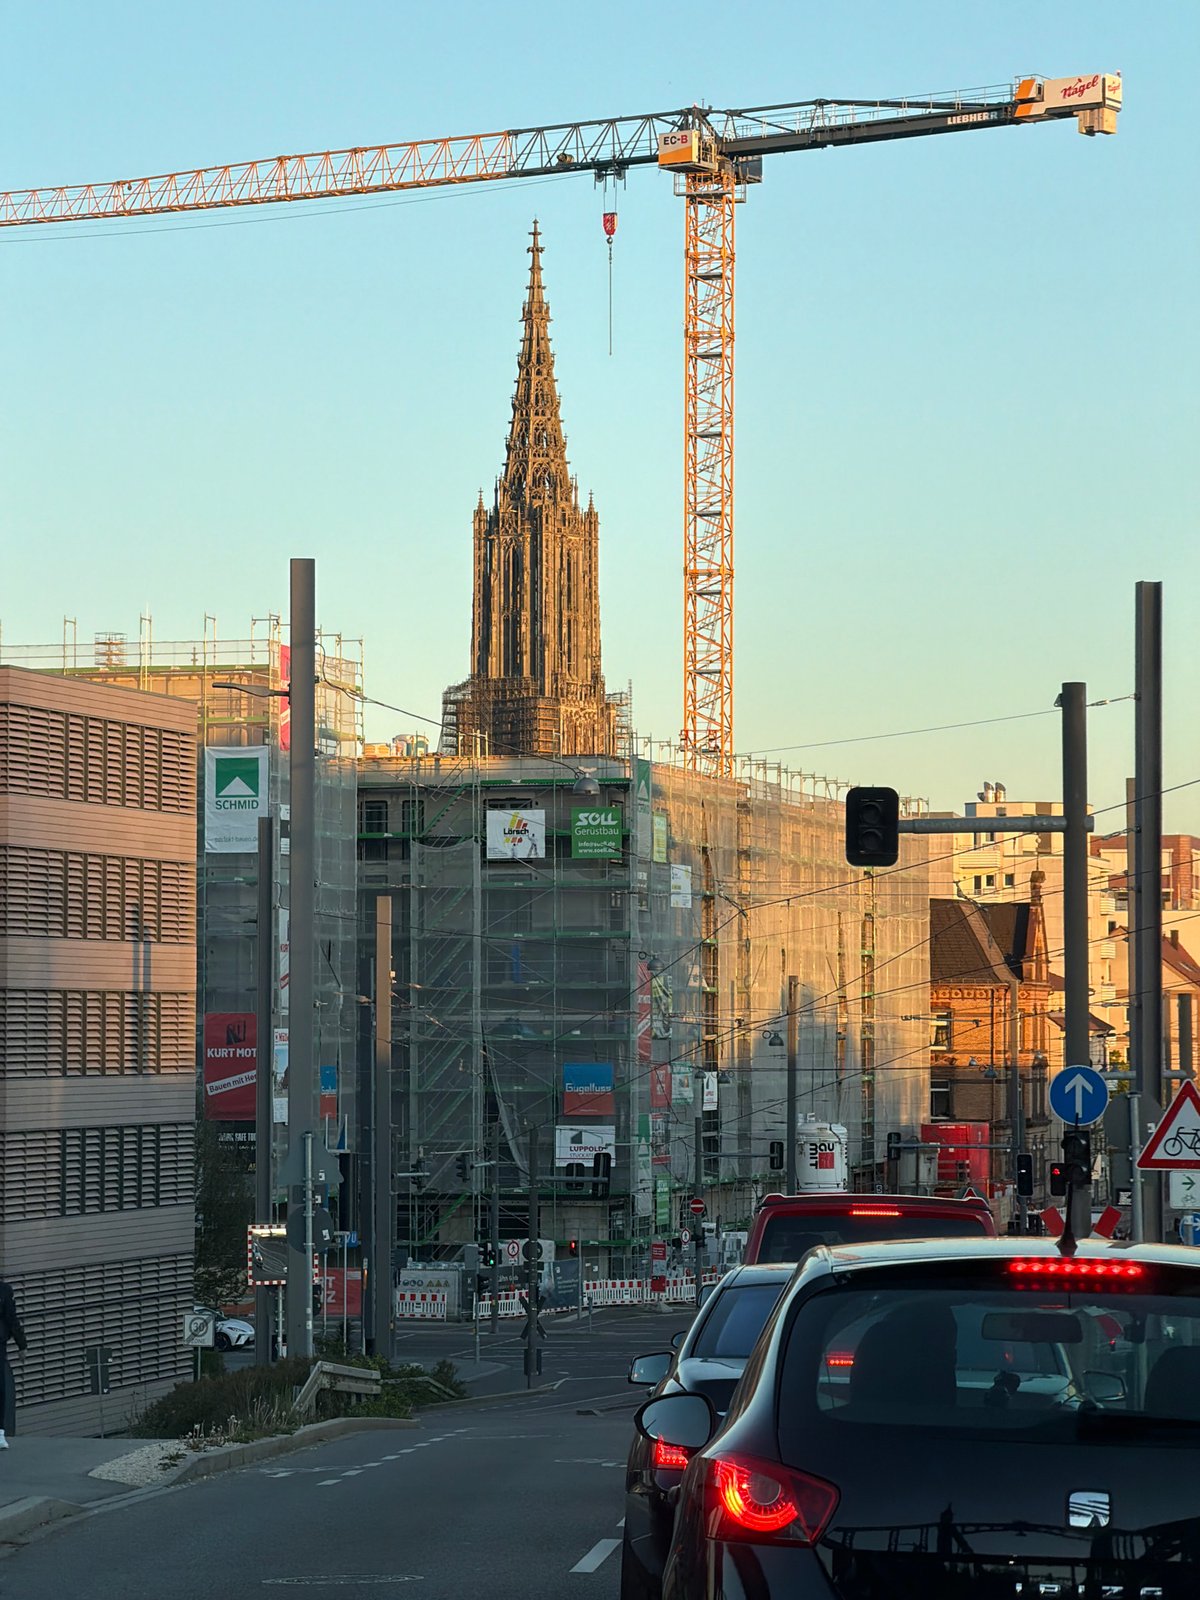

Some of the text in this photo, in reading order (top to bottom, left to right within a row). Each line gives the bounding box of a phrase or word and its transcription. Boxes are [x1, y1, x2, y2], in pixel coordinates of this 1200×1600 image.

[947, 111, 998, 125] LIEBHERR
[663, 134, 688, 145] EC-B
[215, 800, 259, 810] SCHMID
[574, 826, 619, 835] Gerüstbau
[207, 1048, 257, 1058] KURT MOT
[209, 1081, 231, 1092] Bauen
[232, 1077, 244, 1085] mit
